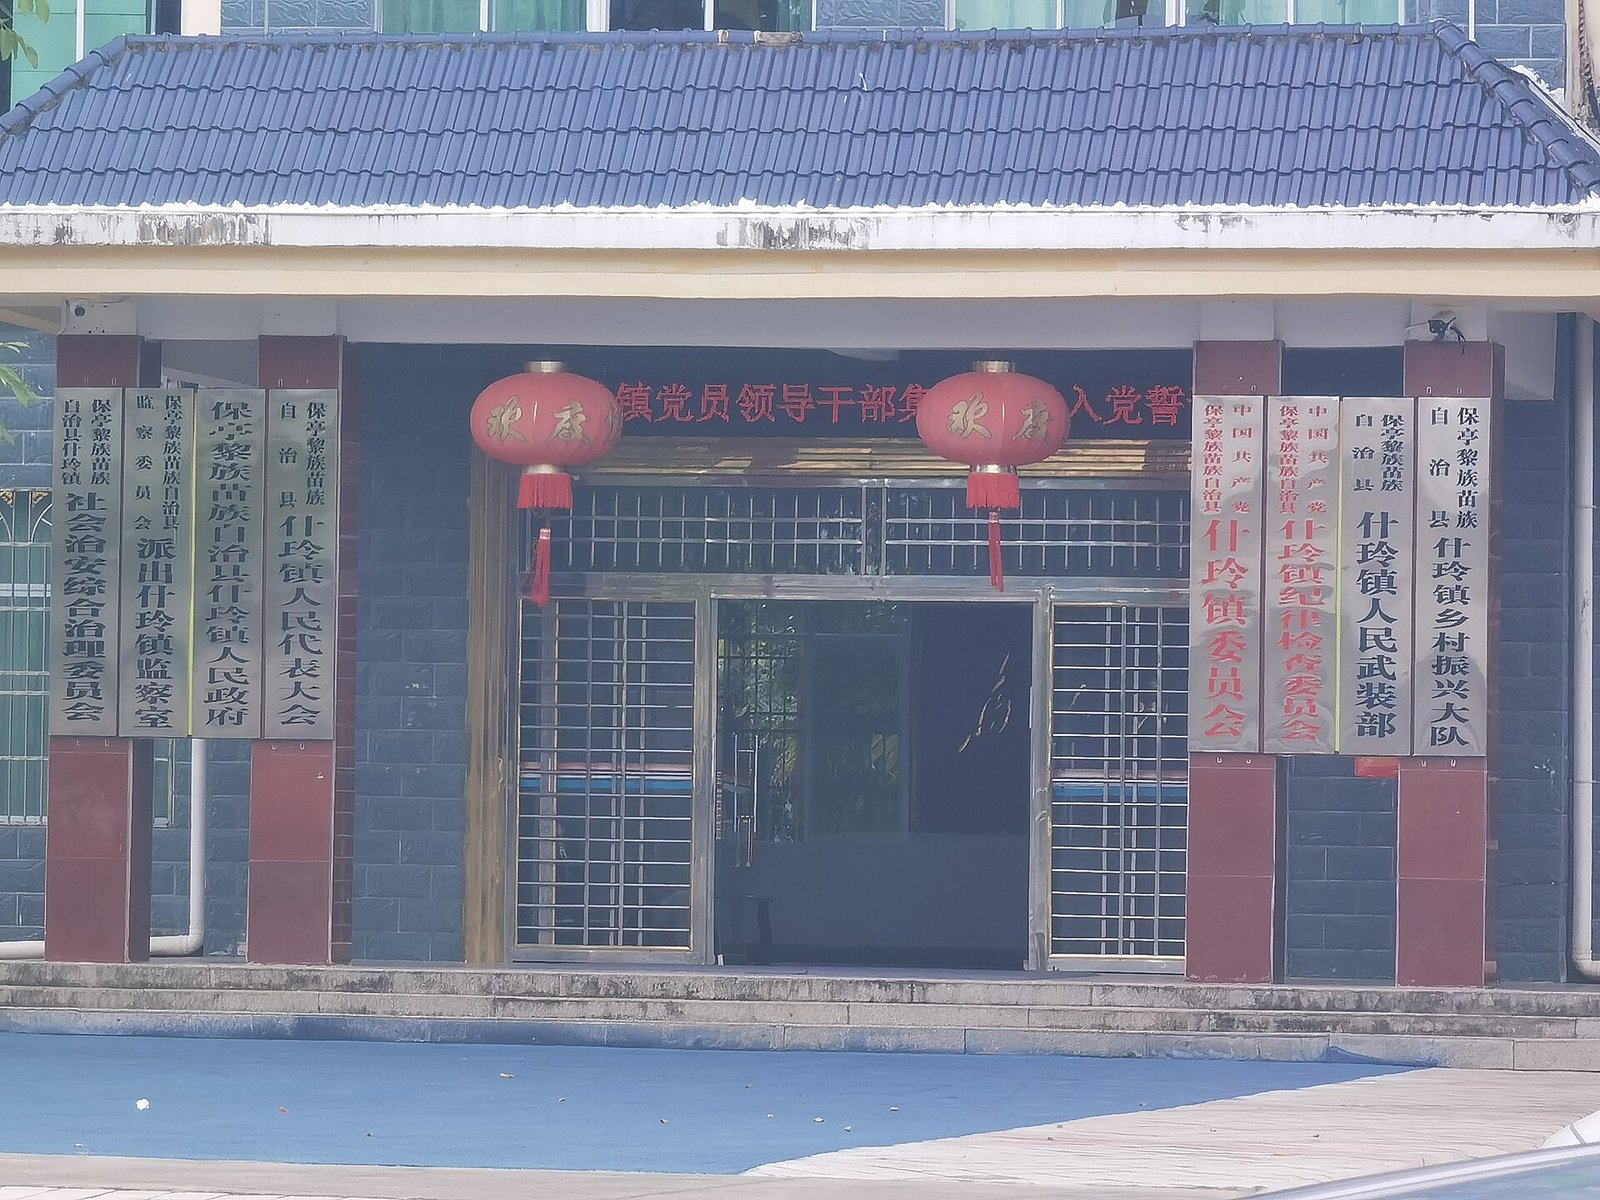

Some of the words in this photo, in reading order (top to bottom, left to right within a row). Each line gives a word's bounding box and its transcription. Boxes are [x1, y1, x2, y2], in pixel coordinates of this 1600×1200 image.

[61, 399, 82, 485] 自治县什玲镇
[90, 399, 112, 485] 保亭黎族苗族
[134, 395, 154, 530] 监察委员会
[162, 395, 182, 530] 保亭黎族苗族自治县
[279, 402, 298, 508] 自治县
[305, 402, 327, 505] 保亭黎族苗族
[1069, 383, 1191, 426] 入党誓
[1202, 404, 1224, 514] 保亭黎族苗族自治县
[1231, 404, 1252, 514] 中国共产党
[1279, 405, 1299, 514] 保亭黎族苗族自治县
[1307, 405, 1328, 514] 中国共产党
[1352, 414, 1374, 491] 自治县
[1380, 414, 1404, 492] 保亭黎族苗族
[1429, 407, 1450, 528] 自治县
[1456, 407, 1479, 529] 保亭黎族苗族
[62, 492, 107, 722] 社会治安综合治理委员会
[203, 401, 253, 726] 保亭黎族苗族自治县什玲镇人民政府
[278, 515, 325, 726] 什玲镇人民代表大会
[134, 538, 176, 728] 派出什玲镇监察室
[1202, 519, 1250, 738] 什玲镇委员会
[1277, 519, 1326, 741] 什玲镇纪律检查委员会
[1355, 511, 1400, 739] 什玲镇人民武装部
[1430, 537, 1472, 746] 什玲镇乡村振兴大队
